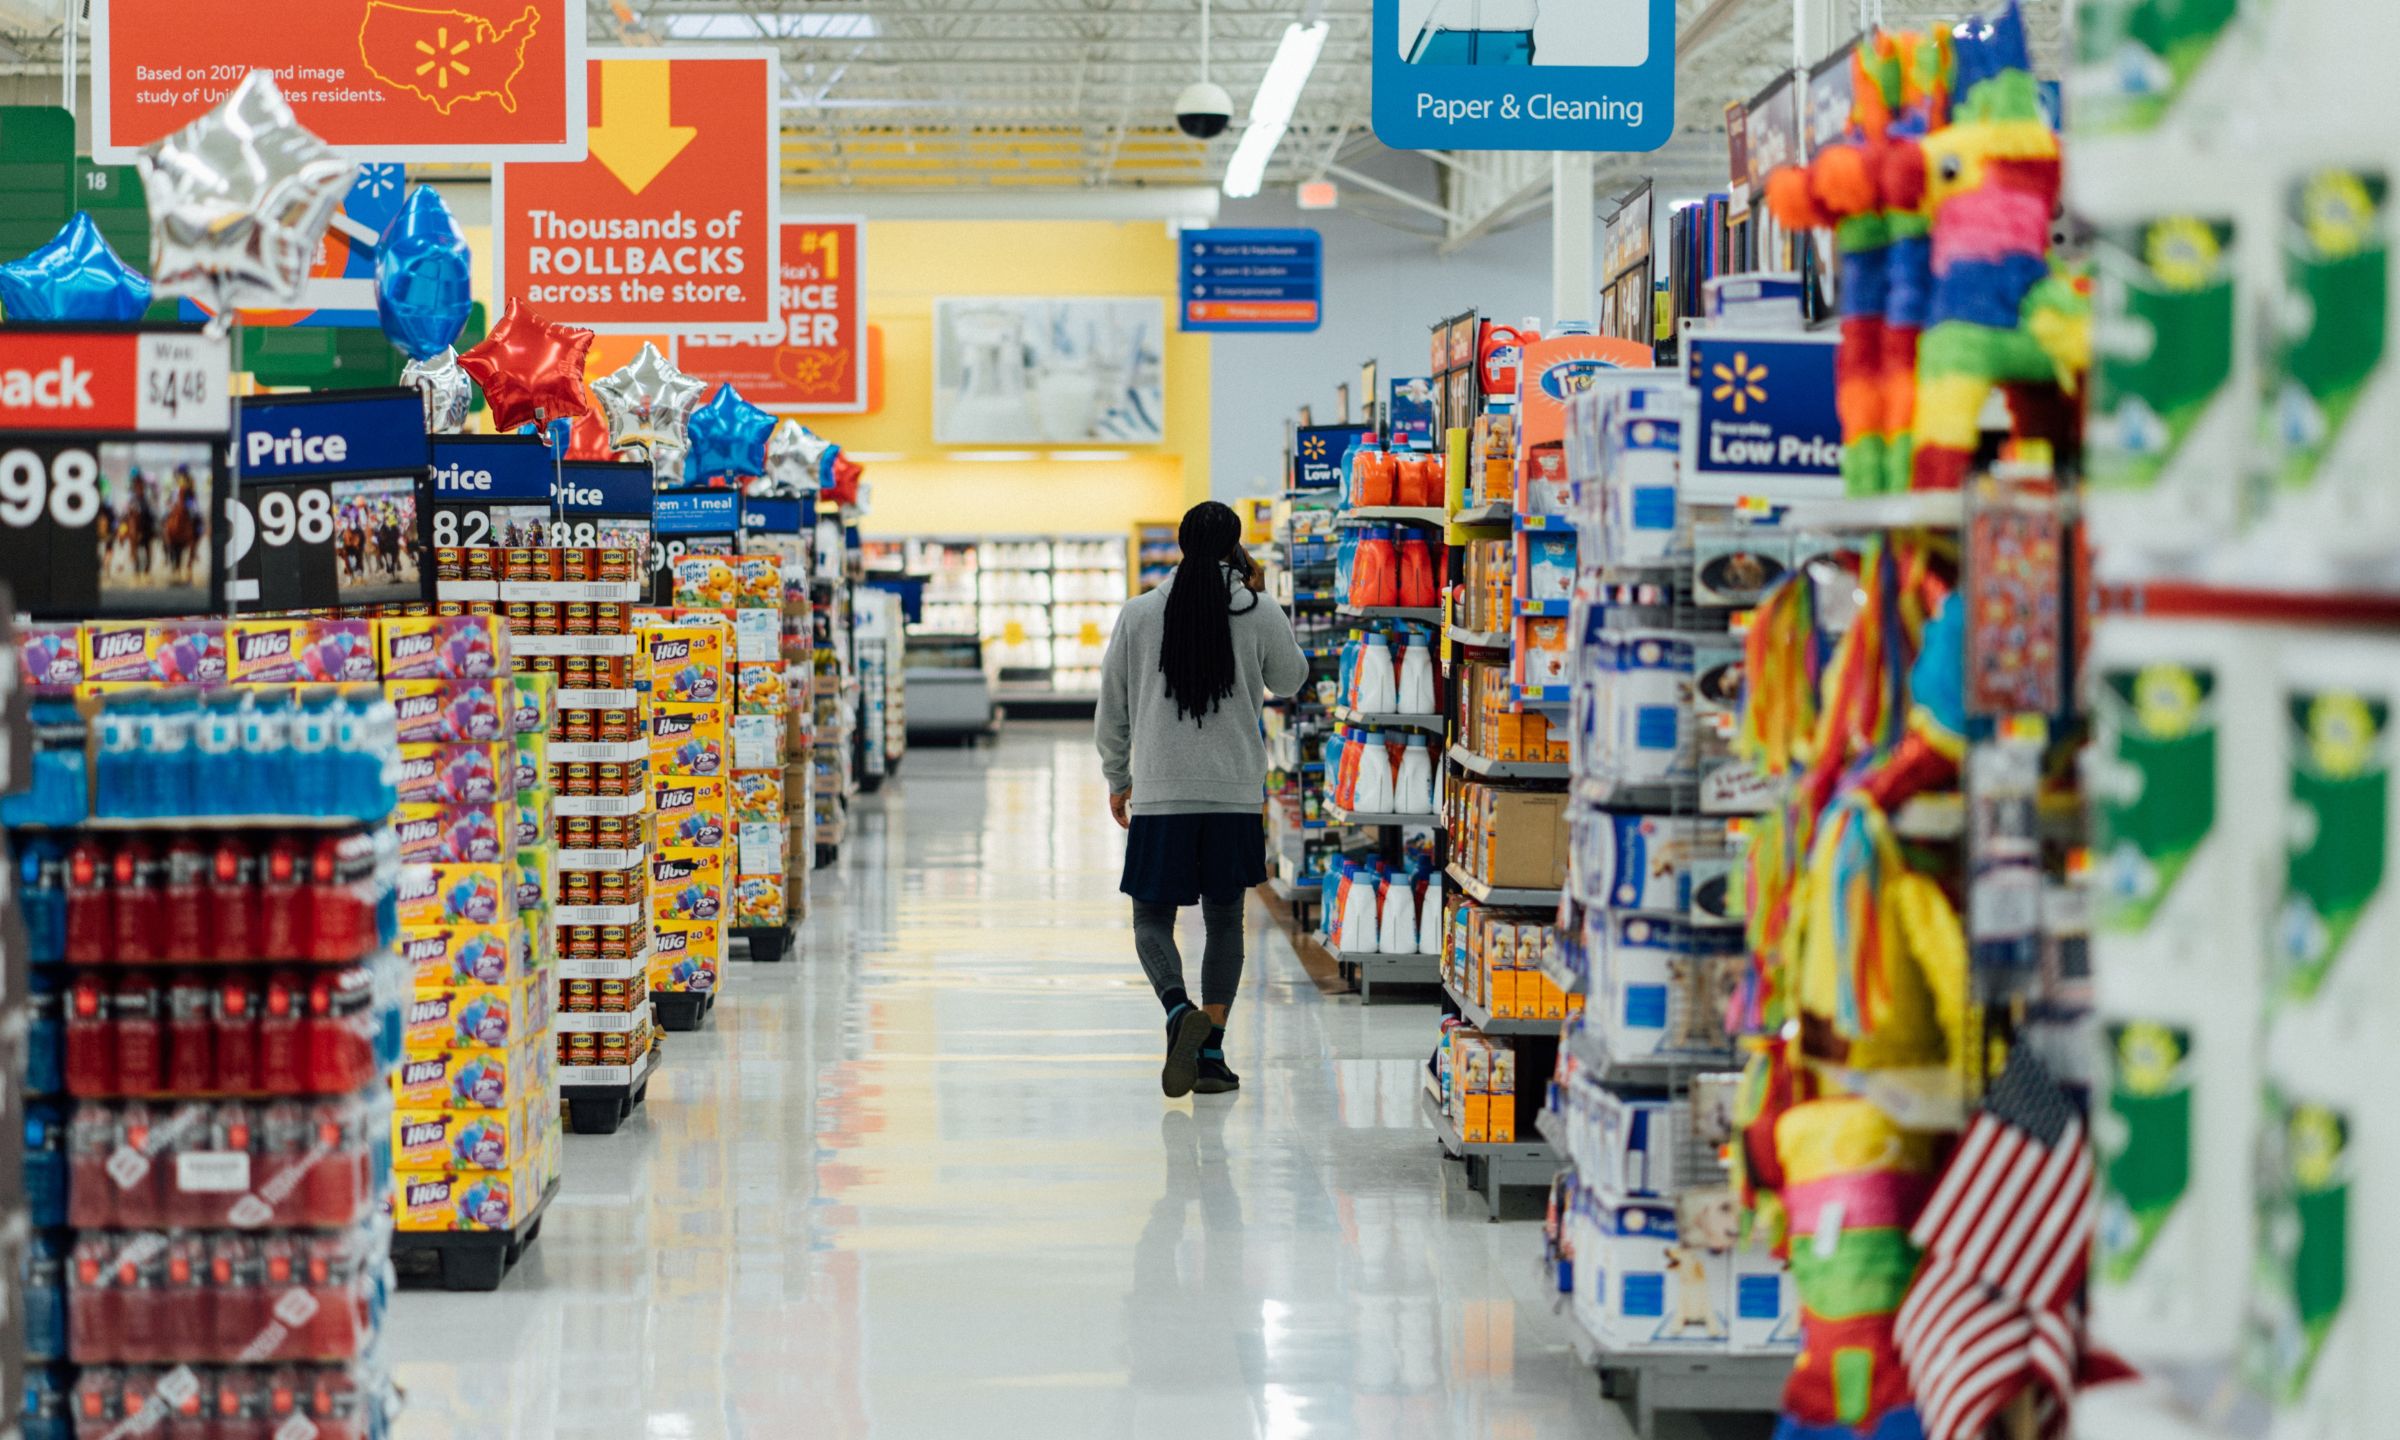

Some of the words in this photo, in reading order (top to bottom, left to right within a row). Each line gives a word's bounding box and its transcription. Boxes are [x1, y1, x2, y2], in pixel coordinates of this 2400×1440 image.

[137, 66, 176, 80] Based
[186, 70, 205, 80] on
[210, 65, 245, 80] 2017
[298, 66, 345, 82] image
[137, 89, 178, 106] study
[183, 88, 199, 102] of
[312, 88, 386, 102] residents.
[1417, 93, 1493, 124] Paper
[1500, 95, 1520, 119] &
[1528, 94, 1643, 127] Cleaning
[86, 172, 107, 190] 18
[528, 210, 697, 239] Thousands
[706, 210, 743, 239] of
[529, 246, 745, 275] ROLLBACKS
[800, 231, 838, 279] #1
[780, 263, 819, 279] ica's
[528, 284, 613, 303] across
[620, 278, 665, 303] the
[672, 281, 746, 303] store.
[780, 285, 838, 309] RICE
[0, 356, 93, 408] ack
[1552, 367, 1595, 399] Tre
[247, 428, 347, 466] Price
[1710, 433, 1774, 464] Low
[1779, 434, 1844, 467] Pric
[1305, 468, 1331, 481] Low
[0, 449, 100, 528] 98
[701, 497, 732, 509] meal
[259, 489, 333, 546] 98
[742, 511, 766, 527] ice
[433, 510, 490, 547] 82
[551, 522, 596, 547] 88
[534, 552, 547, 562] SH'S
[566, 552, 582, 562] USH'S
[604, 552, 624, 562] BUSH'S
[510, 605, 529, 614] BUSH'S
[570, 605, 590, 614] BUSH'S
[99, 635, 143, 660] HUG
[245, 635, 289, 660] HUG
[396, 635, 432, 658] HUG
[655, 644, 687, 660] HUG
[693, 639, 705, 648] 40
[694, 679, 713, 689] 75%
[401, 697, 437, 719] HUG
[605, 713, 625, 721] BUSH'S
[696, 713, 708, 721] 40
[696, 753, 716, 763] 75%
[517, 768, 535, 780] 5%
[662, 791, 693, 808] HUG
[698, 788, 711, 796] 40
[402, 821, 437, 842] HUG
[518, 824, 535, 836] 5%
[699, 826, 719, 836] 75%
[696, 899, 716, 908] 75%
[574, 929, 594, 937] BUSH'S
[604, 929, 623, 937] BUSH'S
[690, 931, 703, 940] 40
[410, 940, 444, 960] HUG
[656, 936, 685, 951] HUG
[692, 970, 711, 980] 75%
[411, 1000, 447, 1022] HUG
[407, 1063, 443, 1085] HUG
[407, 1125, 443, 1146] HUG
[412, 1184, 448, 1206] HUG
